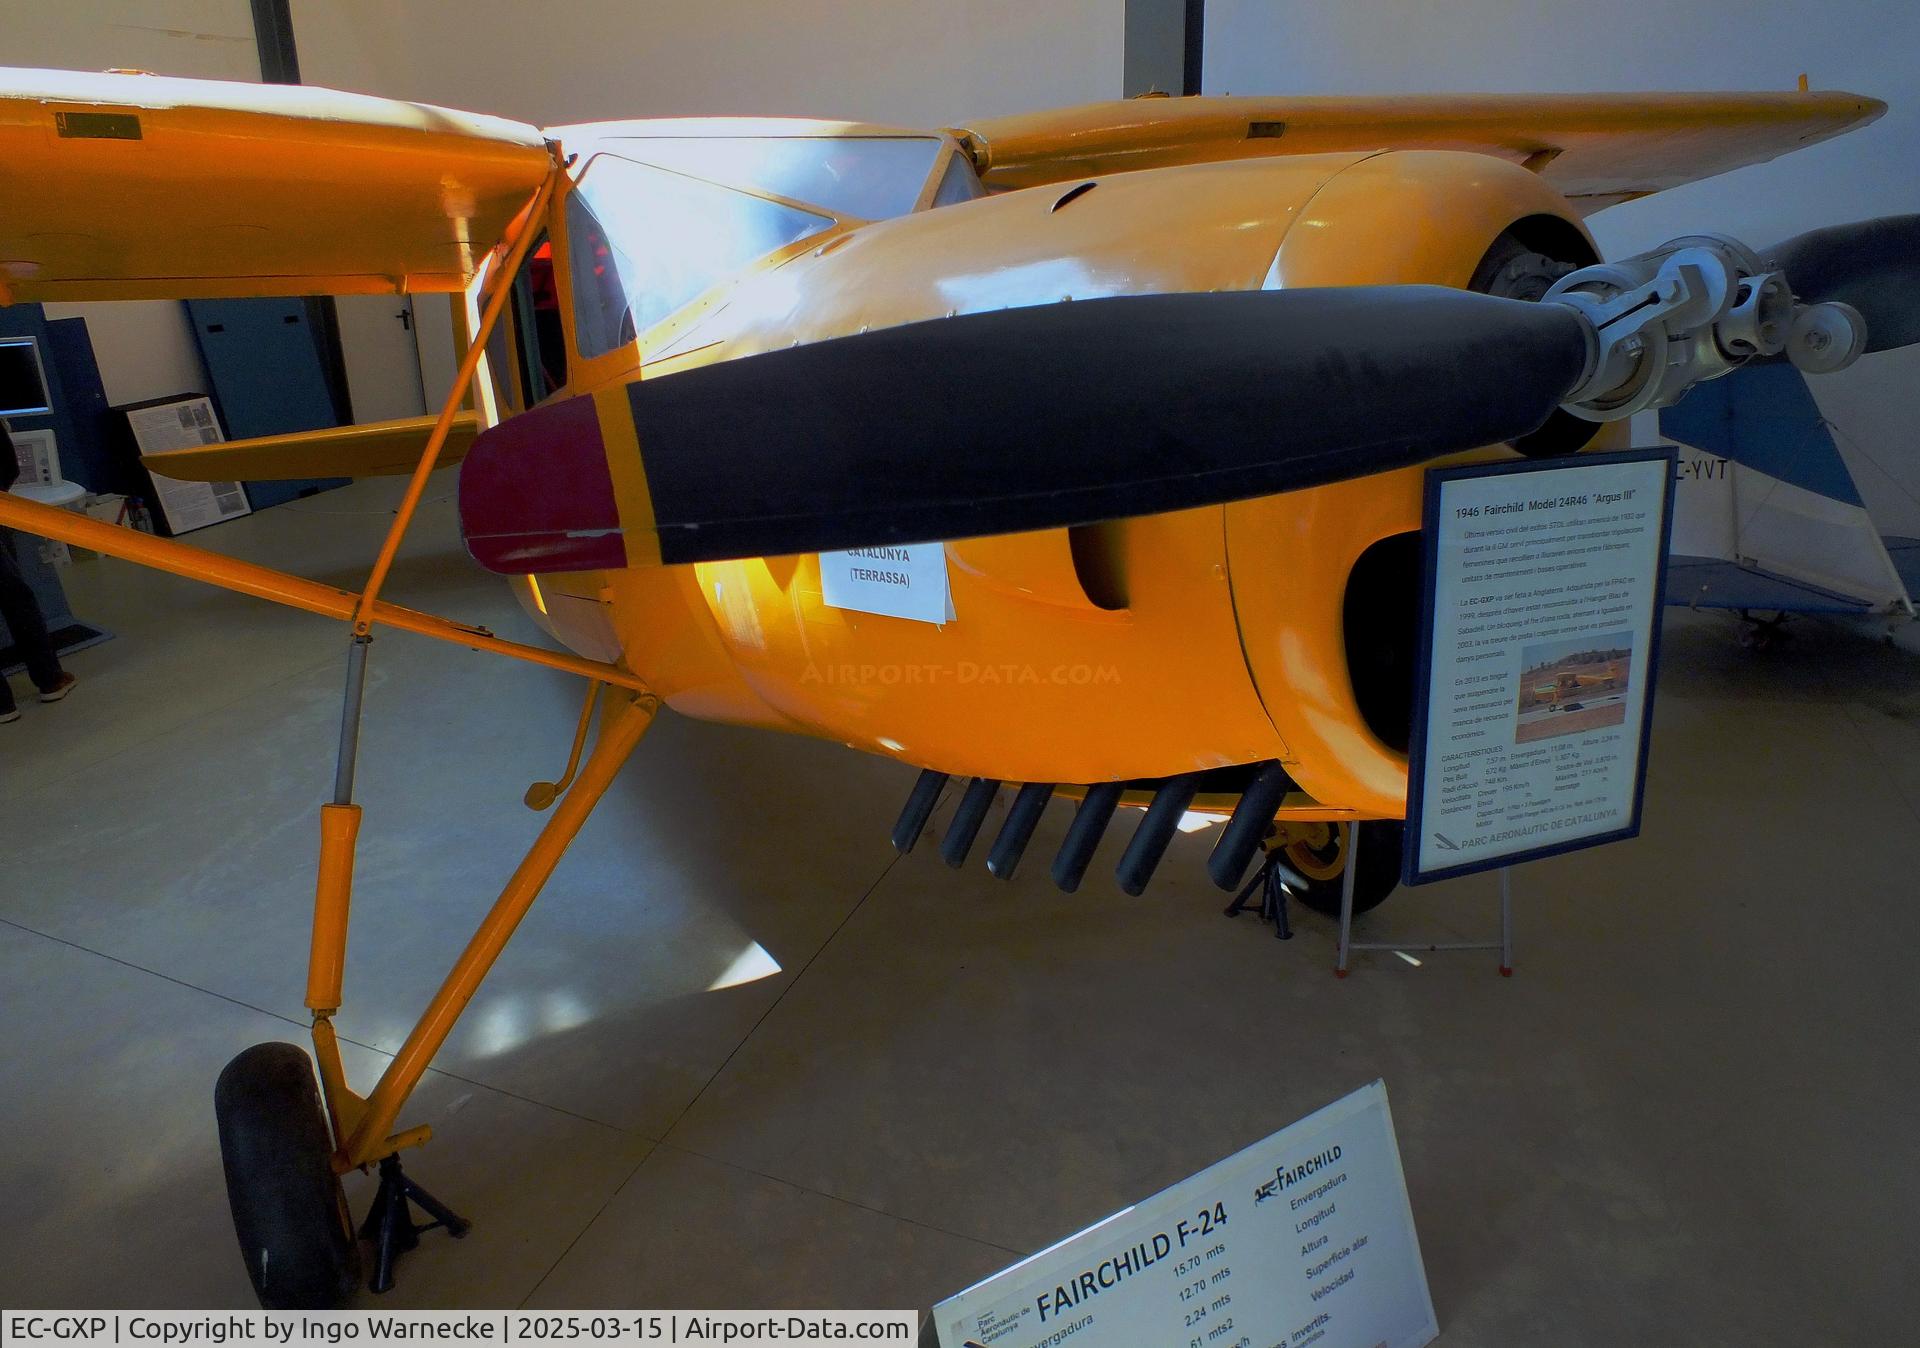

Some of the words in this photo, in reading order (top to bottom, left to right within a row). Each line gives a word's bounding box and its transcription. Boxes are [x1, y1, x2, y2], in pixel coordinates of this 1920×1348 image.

[1455, 506, 1479, 518] 1946
[1484, 501, 1523, 515] Fairchild
[1528, 498, 1556, 510] Model
[1558, 495, 1587, 507] 24R46
[848, 545, 910, 561] CATALUNYA
[850, 567, 910, 589] (TERRASSA)
[1469, 595, 1494, 604] EC-GXP
[1443, 761, 1470, 773] Longitud
[1461, 835, 1488, 849] PARC
[1550, 819, 1563, 830] DE
[1564, 807, 1617, 826] CATALUNYA
[1290, 1172, 1347, 1210] Envergadura
[1295, 1202, 1336, 1234] Longitud
[1301, 1234, 1328, 1257] Altura
[1305, 1244, 1350, 1280] Superficie
[1351, 1234, 1369, 1252] alar
[1036, 1233, 1170, 1322] FAIRCHILD
[1177, 1201, 1228, 1247] F-24
[1173, 1255, 1201, 1278] 15.70
[1206, 1243, 1226, 1261] mts
[1179, 1279, 1206, 1302] 12.70
[1211, 1267, 1231, 1285] mts
[1310, 1268, 1355, 1302] Velocidad
[978, 1316, 995, 1330] Parc
[1021, 1307, 1031, 1316] de
[1185, 1306, 1207, 1327] 2,24
[1211, 1294, 1231, 1312] mts
[982, 1322, 1018, 1345] Catalunya
[1030, 1314, 1094, 1348] vergadura
[1208, 1318, 1234, 1341] mts2
